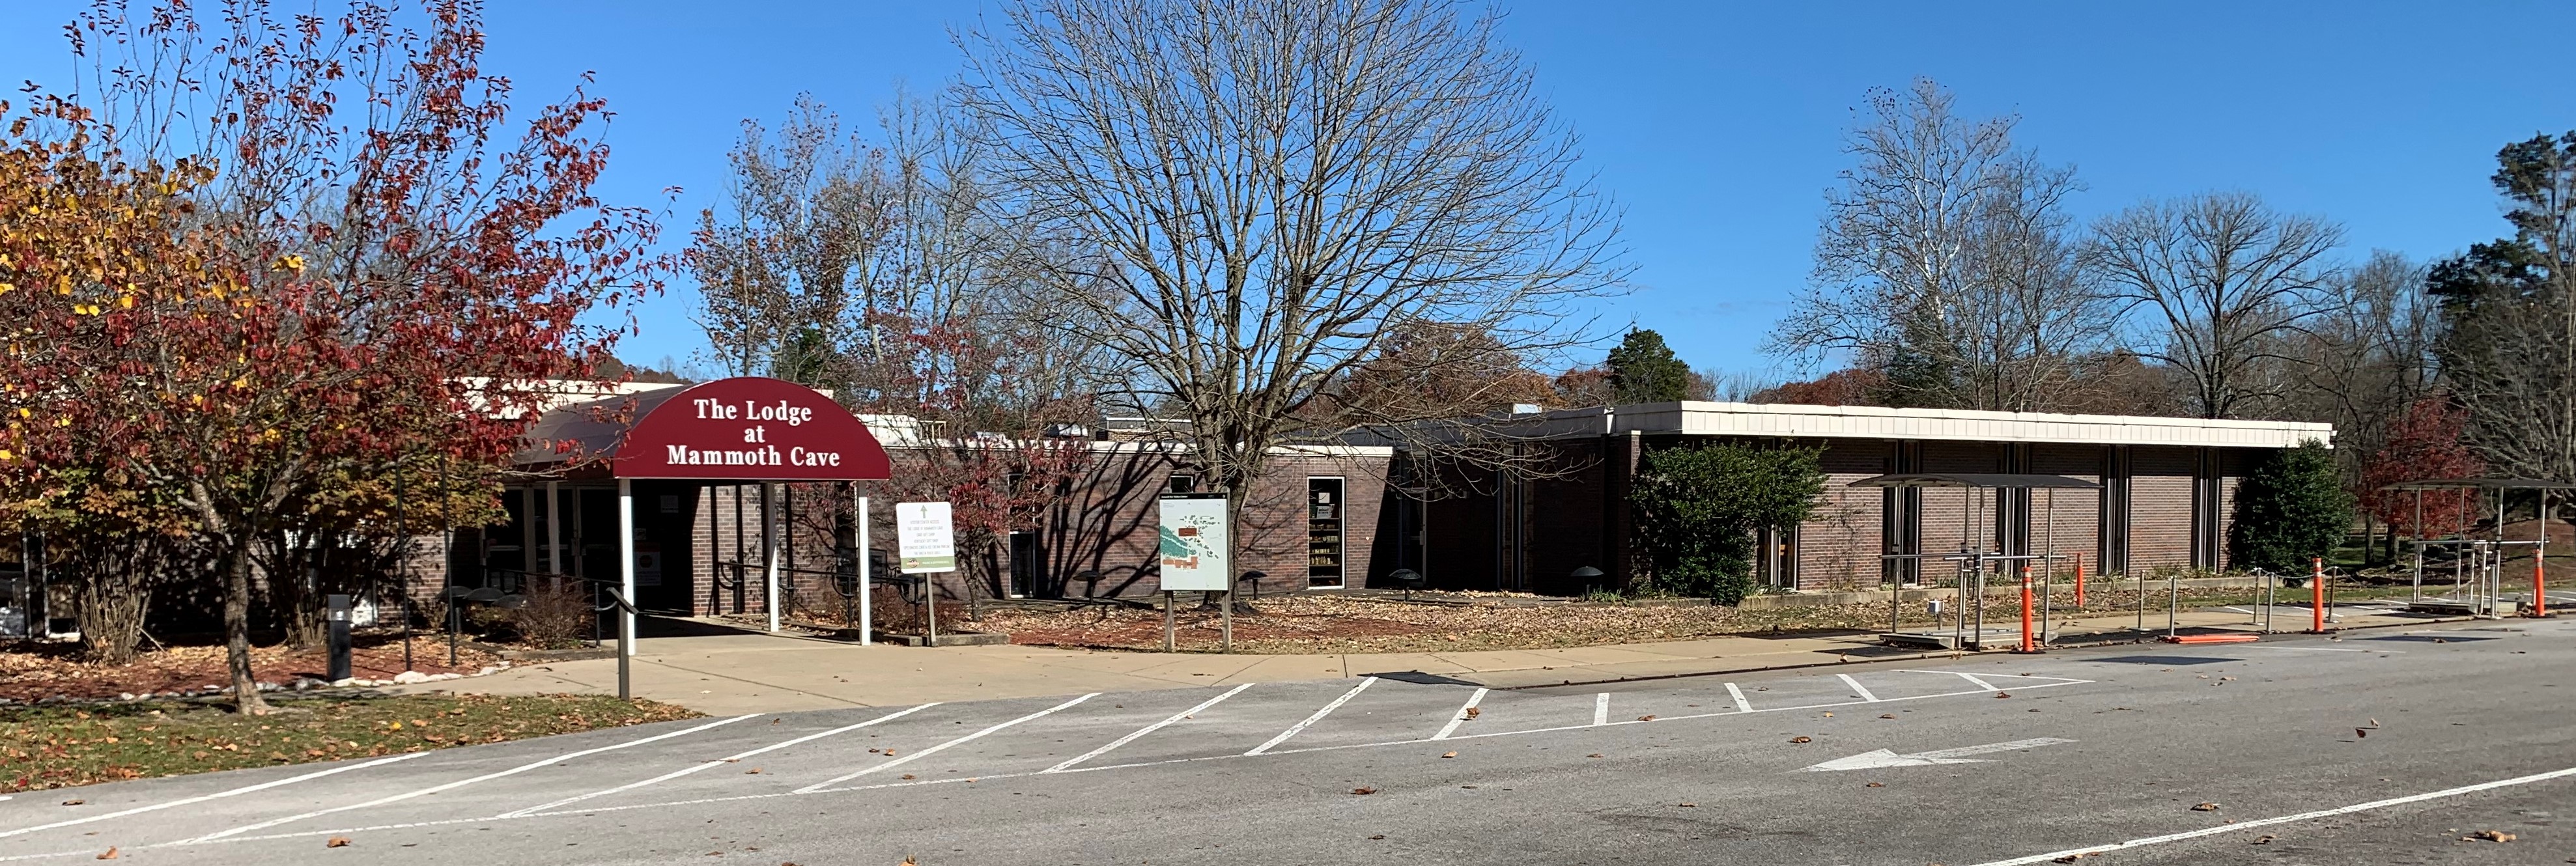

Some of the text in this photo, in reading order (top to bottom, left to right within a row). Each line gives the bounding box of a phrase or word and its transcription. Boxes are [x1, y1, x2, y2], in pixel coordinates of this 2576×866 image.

[694, 398, 812, 426] The Lodge
[744, 425, 765, 443] at
[666, 445, 840, 467] Mammoth Cave
